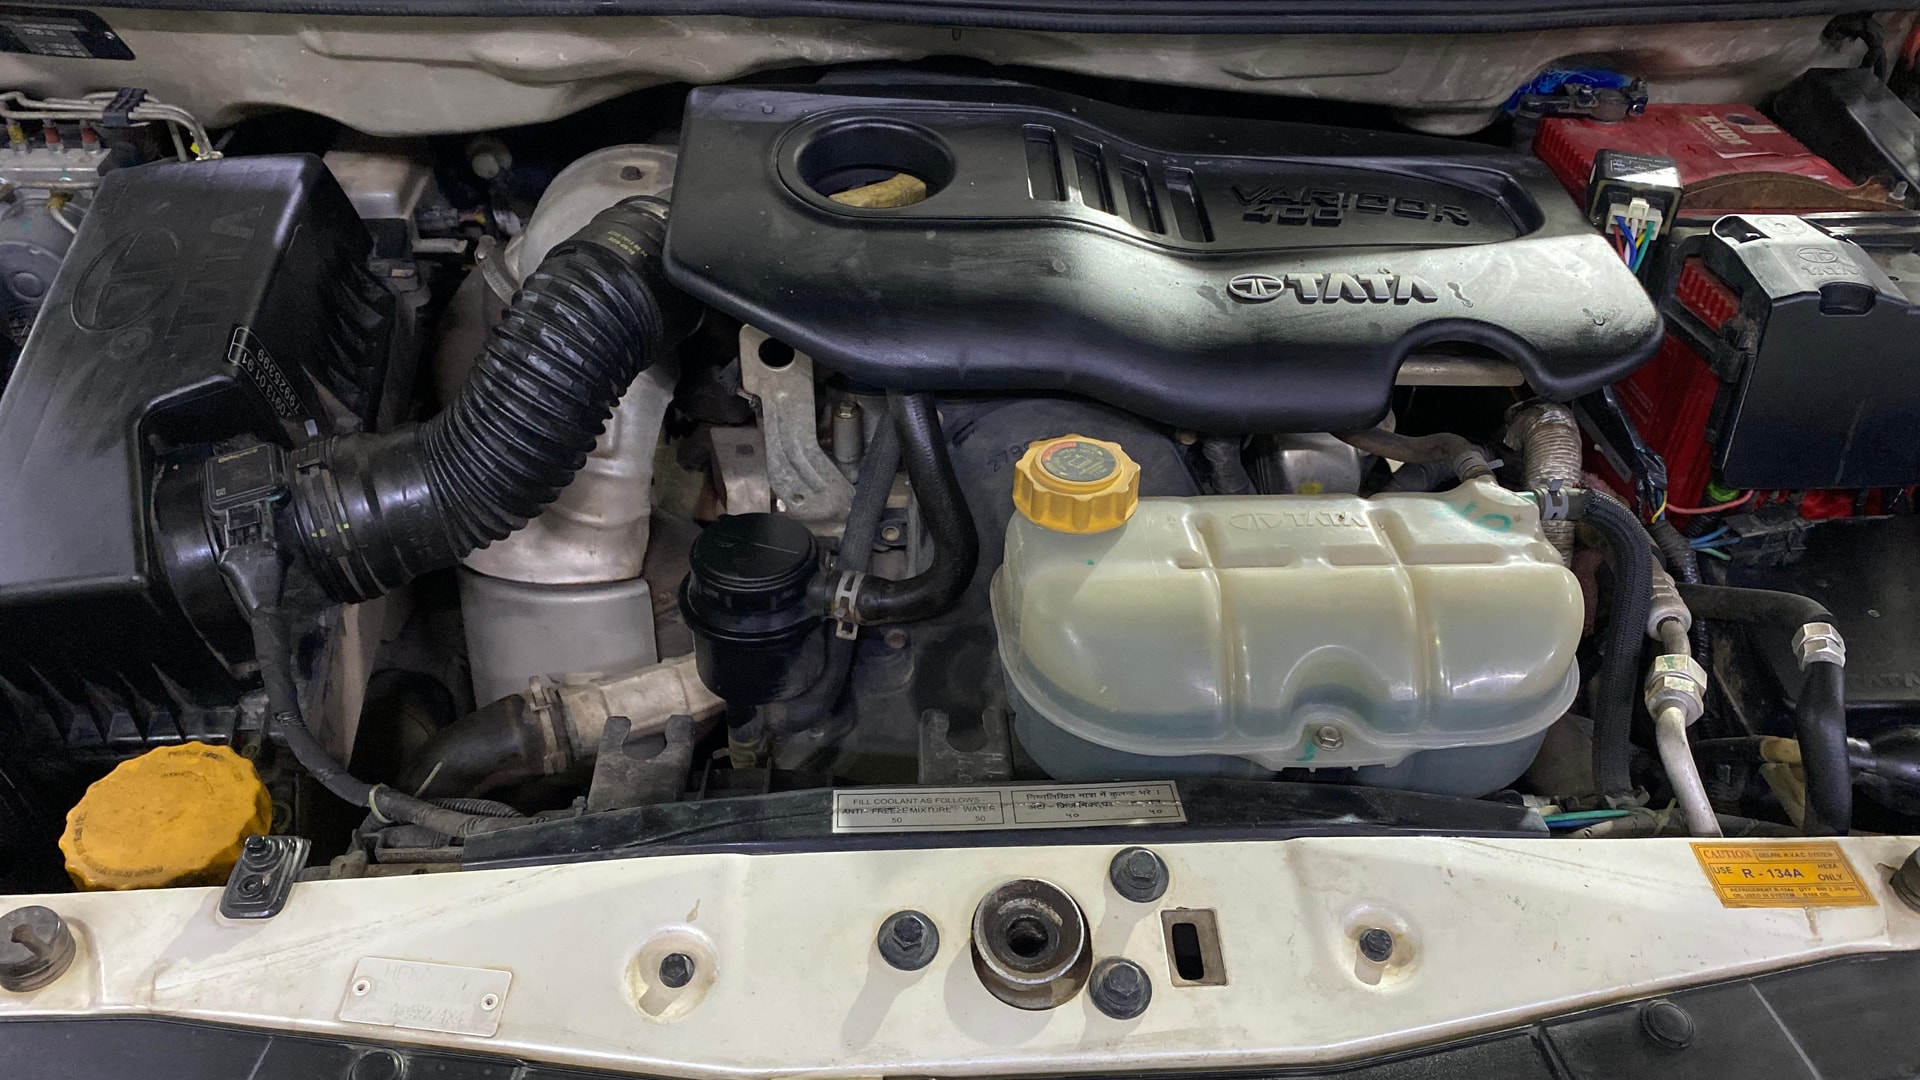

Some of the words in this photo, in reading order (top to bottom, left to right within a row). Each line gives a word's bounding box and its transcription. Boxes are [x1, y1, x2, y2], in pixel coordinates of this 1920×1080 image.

[1242, 203, 1344, 228] 400
[1284, 272, 1439, 305] TATA
[873, 798, 918, 806] COOLANT
[909, 805, 952, 814] MIXTURE
[962, 804, 996, 813] WATER
[891, 816, 903, 824] 50
[1702, 849, 1753, 860] CAUTION
[1712, 866, 1734, 875] USE
[1818, 873, 1844, 881] ONLY
